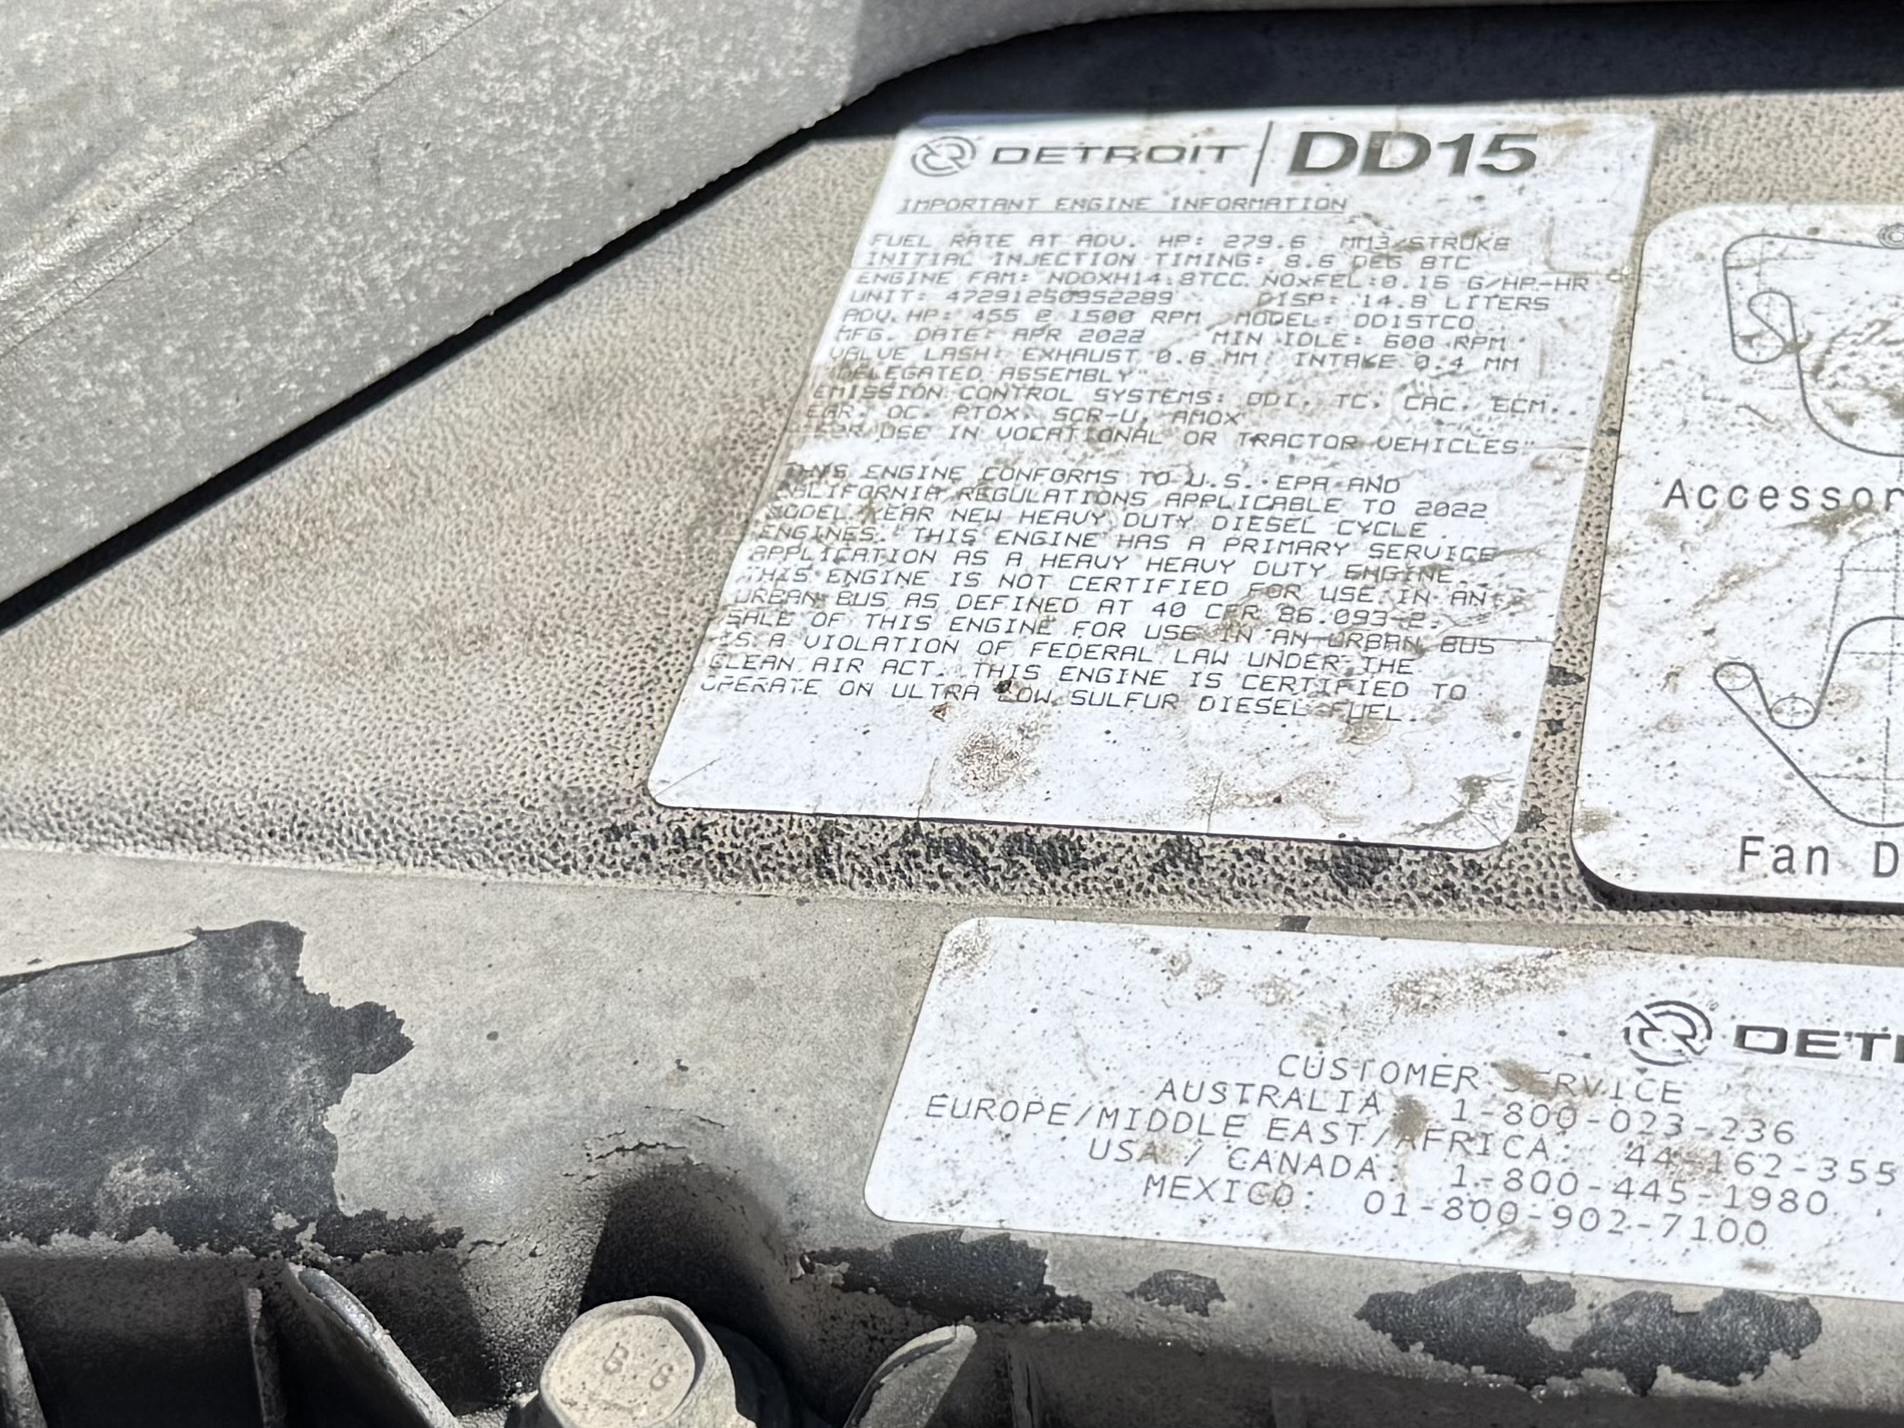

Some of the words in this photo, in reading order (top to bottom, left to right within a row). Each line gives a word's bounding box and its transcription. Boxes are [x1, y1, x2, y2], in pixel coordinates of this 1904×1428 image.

[992, 145, 1245, 165] DETROIT
[1288, 130, 1538, 177] DD15
[900, 197, 1040, 212] IMPORTANT
[1055, 197, 1154, 212] ENGINE
[1170, 196, 1348, 212] INFORMATION
[869, 234, 932, 248] FUEL
[949, 234, 1014, 248] RATE
[1028, 234, 1062, 248] AT
[1076, 234, 1136, 248] ADV.
[1158, 234, 1203, 249] HP:
[1223, 234, 1307, 249] 279.6
[866, 252, 973, 267] INITIAL
[993, 252, 1137, 267] INJECTION
[1155, 253, 1263, 268] TIMING:
[1285, 253, 1336, 269] 8.6
[1420, 256, 1472, 271] BTC
[856, 270, 953, 285] ENGINE
[968, 271, 1028, 286] FAM:
[850, 289, 925, 303] UNIT:
[1256, 292, 1337, 307] DISP:
[1445, 294, 1550, 312] LITERS
[972, 309, 1019, 324] 455
[1069, 309, 1136, 325] 1500
[1150, 310, 1202, 326] RPM
[1234, 311, 1332, 328] MODEL:
[916, 328, 991, 342] DATE:
[1012, 328, 1062, 343] APR
[1078, 329, 1146, 344] 2022
[1212, 331, 1264, 346] MIN
[1283, 332, 1362, 348] IDLE:
[1384, 334, 1435, 350] 600
[1454, 335, 1507, 352] RPM
[924, 347, 1000, 362] LASH:
[1022, 347, 1140, 365] EXHAUST
[1156, 349, 1207, 365] 0.6
[1294, 353, 1397, 370] INTAKE
[1414, 355, 1464, 371] 0.4
[1484, 356, 1520, 373] MM
[812, 384, 943, 400] EMISSION
[958, 385, 1073, 403] CONTROL
[1093, 387, 1224, 405] SYSTEMS:
[1170, 409, 1241, 426] AMOX
[879, 424, 933, 441] USE
[948, 425, 980, 441] IN
[996, 426, 1162, 446] VOCATIONAL
[1183, 431, 1217, 447] OR
[1237, 432, 1359, 451] TRACTOR
[862, 464, 966, 481] ENGINE
[981, 465, 1119, 485] CONFORMS
[1139, 470, 1170, 487] TO
[1276, 474, 1330, 491] EPA
[1346, 475, 1401, 494] AND
[956, 486, 1149, 507] REGULATIONS
[1164, 492, 1343, 514] APPLICABLE
[1363, 498, 1396, 516] TO
[1414, 500, 1488, 519] 2022
[951, 507, 1003, 523] NEW
[1017, 509, 1107, 526] HEAVY
[1123, 512, 1195, 530] DUTY
[1211, 515, 1317, 534] DIESEL
[1336, 519, 1428, 539] CYCLE
[913, 527, 978, 545] THIS
[994, 529, 1103, 549] ENGINE
[1116, 533, 1171, 551] HAS
[1187, 535, 1205, 552] A
[1222, 537, 1350, 557] PRIMARY
[1367, 542, 1497, 563] SERVICE
[952, 549, 989, 567] AS
[1004, 551, 1023, 568] A
[1039, 552, 1129, 571] HEAVY
[1145, 555, 1236, 575] HEAVY
[1253, 560, 1326, 579] DUTY
[826, 568, 930, 587] ENGINE
[949, 571, 982, 588] IS
[998, 573, 1053, 590] NOT
[1068, 575, 1228, 597] CERTIFIED
[1248, 581, 1302, 601] FOR
[1320, 585, 1376, 604] USE
[1396, 588, 1431, 608] IN
[1450, 590, 1487, 607] AN
[835, 590, 889, 608] BUS
[904, 592, 940, 610] AS
[956, 593, 1079, 614] DEFINED
[1097, 598, 1134, 616] AT
[1152, 601, 1186, 619] 40
[725, 609, 795, 627] SALE
[810, 612, 846, 628] OF
[865, 613, 932, 632] THIS
[949, 616, 1057, 636] ENGINE
[1072, 620, 1126, 638] FOR
[1144, 624, 1199, 641] USE
[1219, 626, 1253, 644] IN
[1270, 628, 1309, 647] AN
[1439, 635, 1495, 655] BUS
[767, 632, 786, 649] A
[802, 634, 960, 655] VIOLATION
[976, 639, 1014, 656] OF
[1028, 641, 1153, 663] FEDERAL
[1174, 648, 1229, 666] LAW
[1247, 650, 1340, 672] UNDER
[1361, 655, 1416, 676] THE
[708, 653, 796, 671] CLEAN
[811, 655, 865, 674] AIR
[974, 661, 1042, 681] THIS
[1058, 665, 1169, 687] ENGINE
[1188, 671, 1224, 690] IS
[1241, 674, 1410, 698] CERTIFIED
[1432, 682, 1468, 702] TO
[838, 679, 875, 698] ON
[891, 682, 980, 702] ULTRA
[1069, 688, 1179, 710] SULFUR
[1197, 694, 1308, 717] DIESEL
[1738, 834, 1831, 877] Fan
[1278, 1053, 1480, 1093] CUSTOMER
[1499, 1063, 1684, 1106] RVICE
[925, 1092, 1247, 1139] EUROPE/MIDDLE
[1451, 1099, 1795, 1147] 1-800-023-236
[1088, 1136, 1162, 1166] USA
[1452, 1163, 1829, 1217] 1-800-445-1980
[1364, 1189, 1769, 1247] 01-800-902-7100
